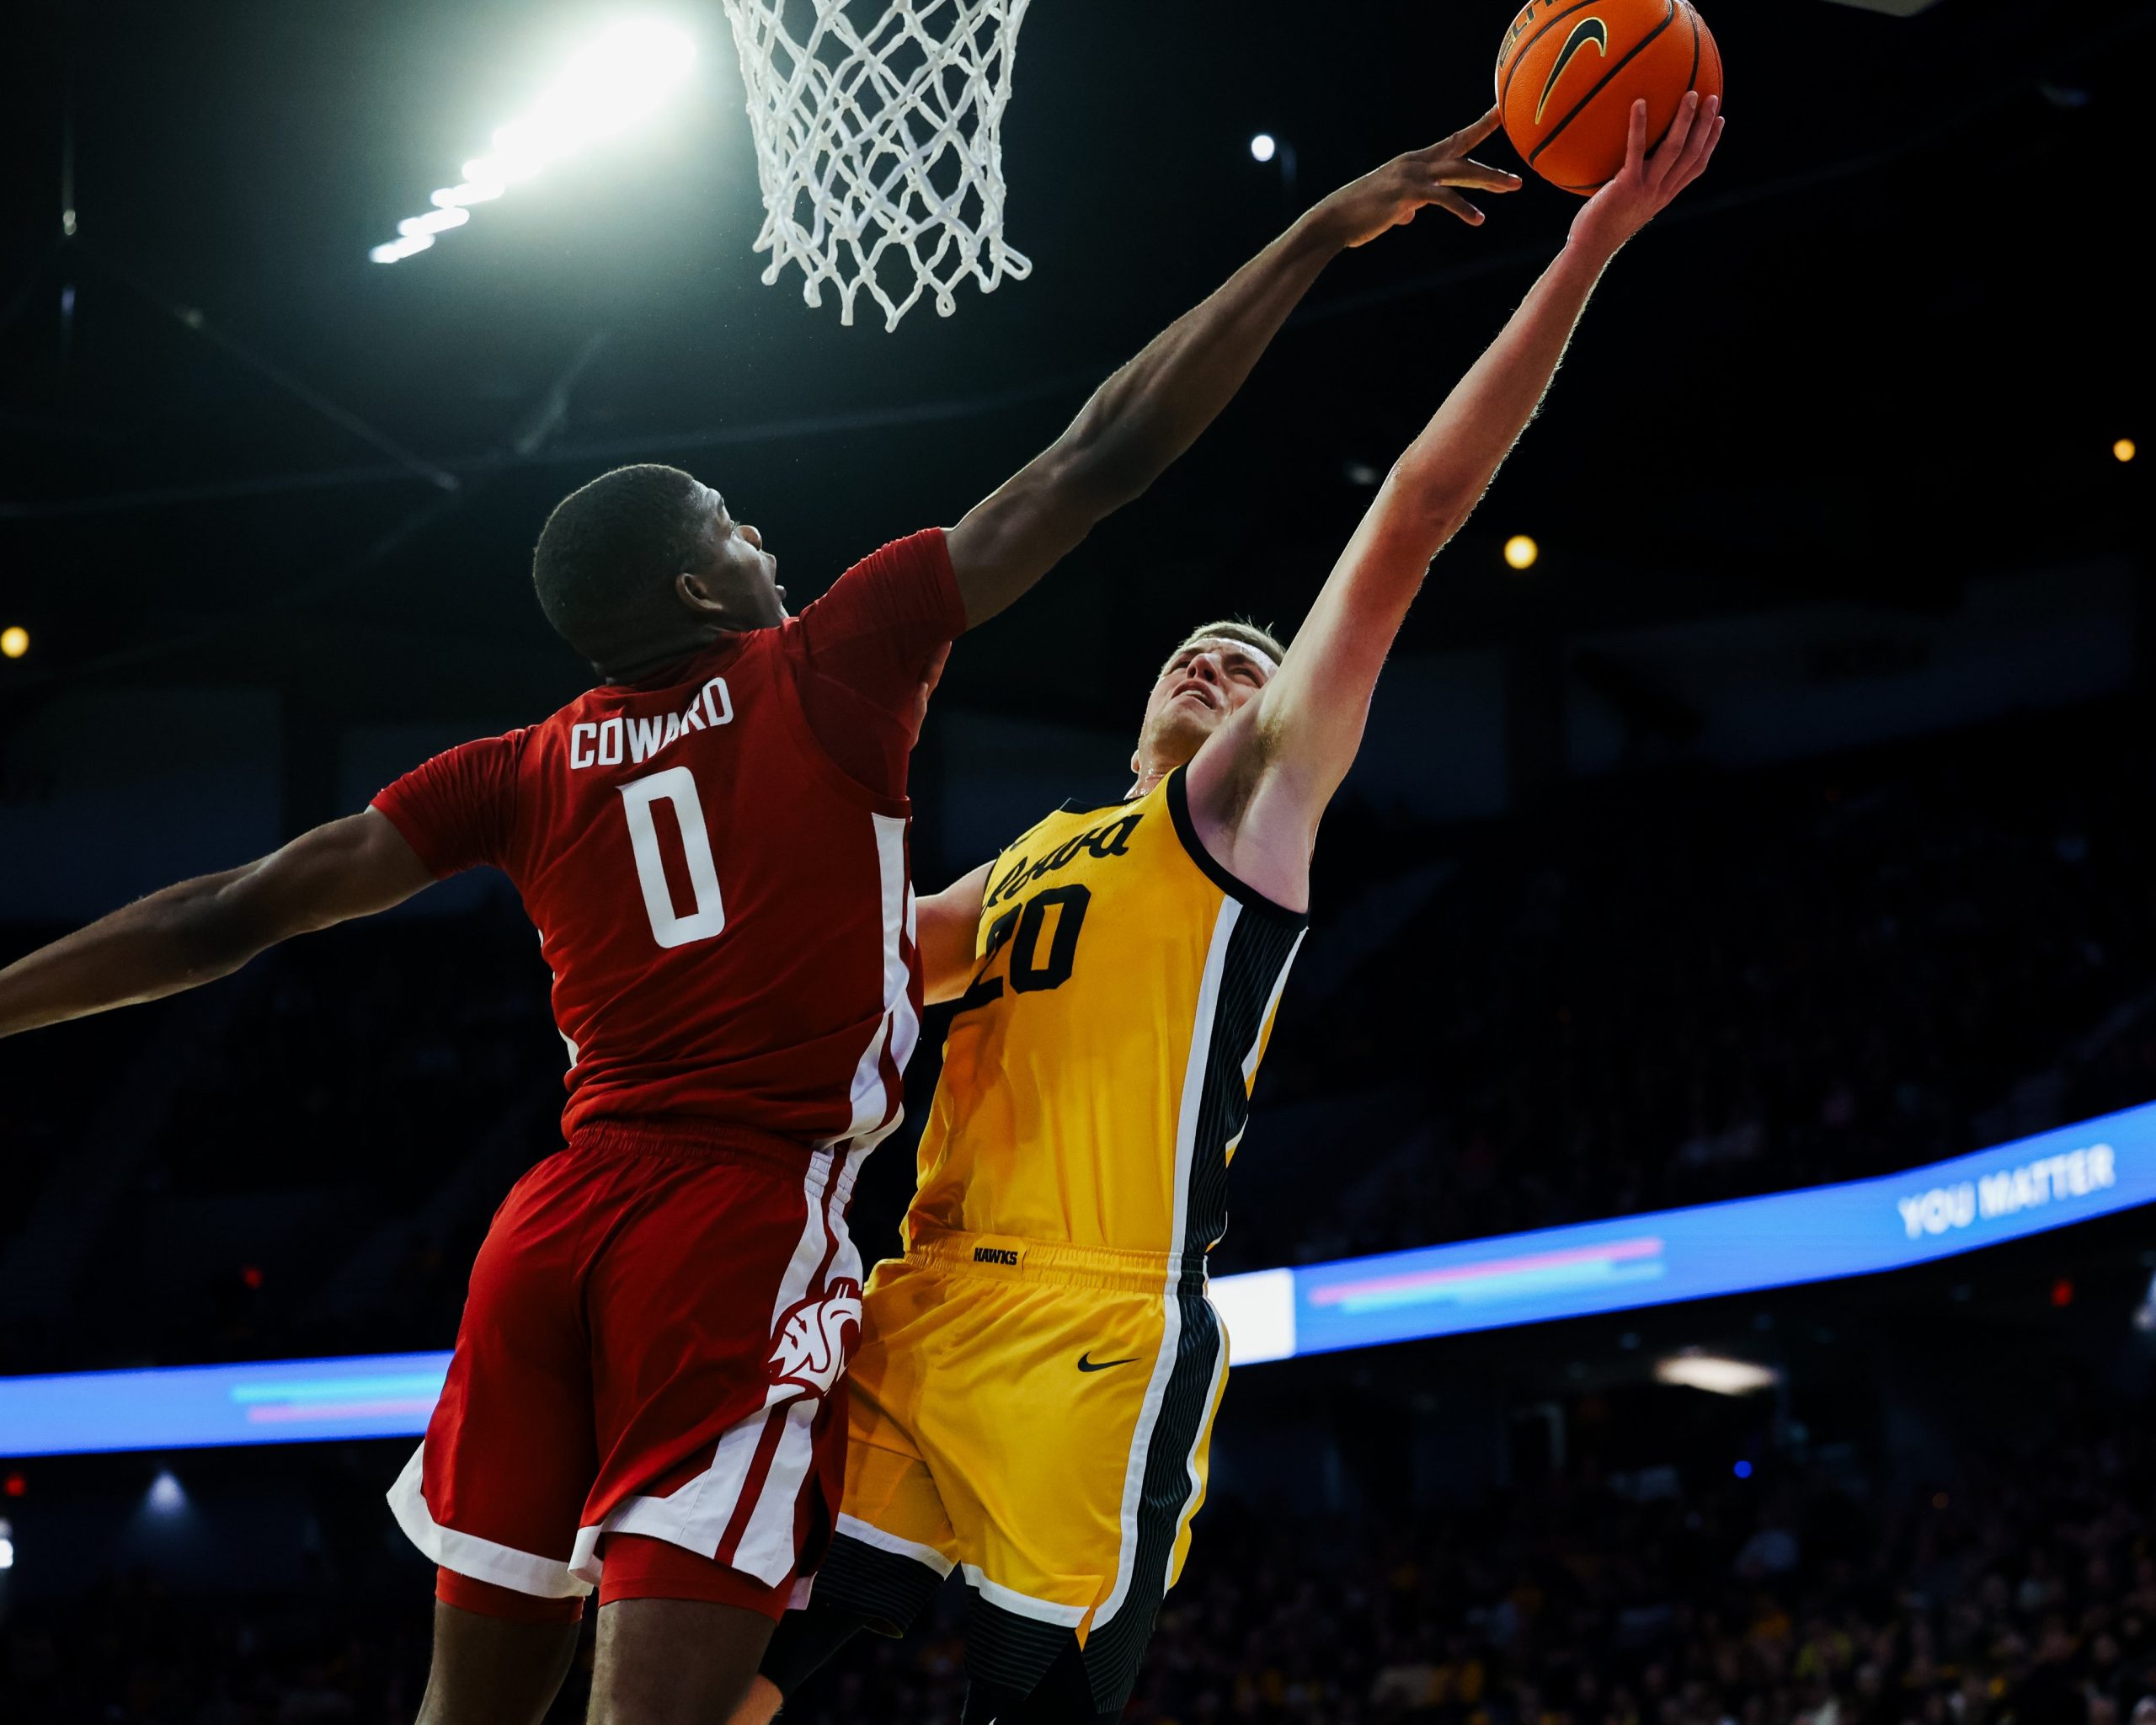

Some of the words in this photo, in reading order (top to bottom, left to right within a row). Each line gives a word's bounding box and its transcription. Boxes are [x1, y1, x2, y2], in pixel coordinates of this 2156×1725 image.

[570, 676, 734, 770] COWARD
[615, 766, 725, 949] 0
[960, 884, 1091, 1011] 20
[1898, 1181, 1976, 1240] YOU
[1978, 1143, 2116, 1220] MATTER
[974, 1247, 1018, 1266] HAWKS
